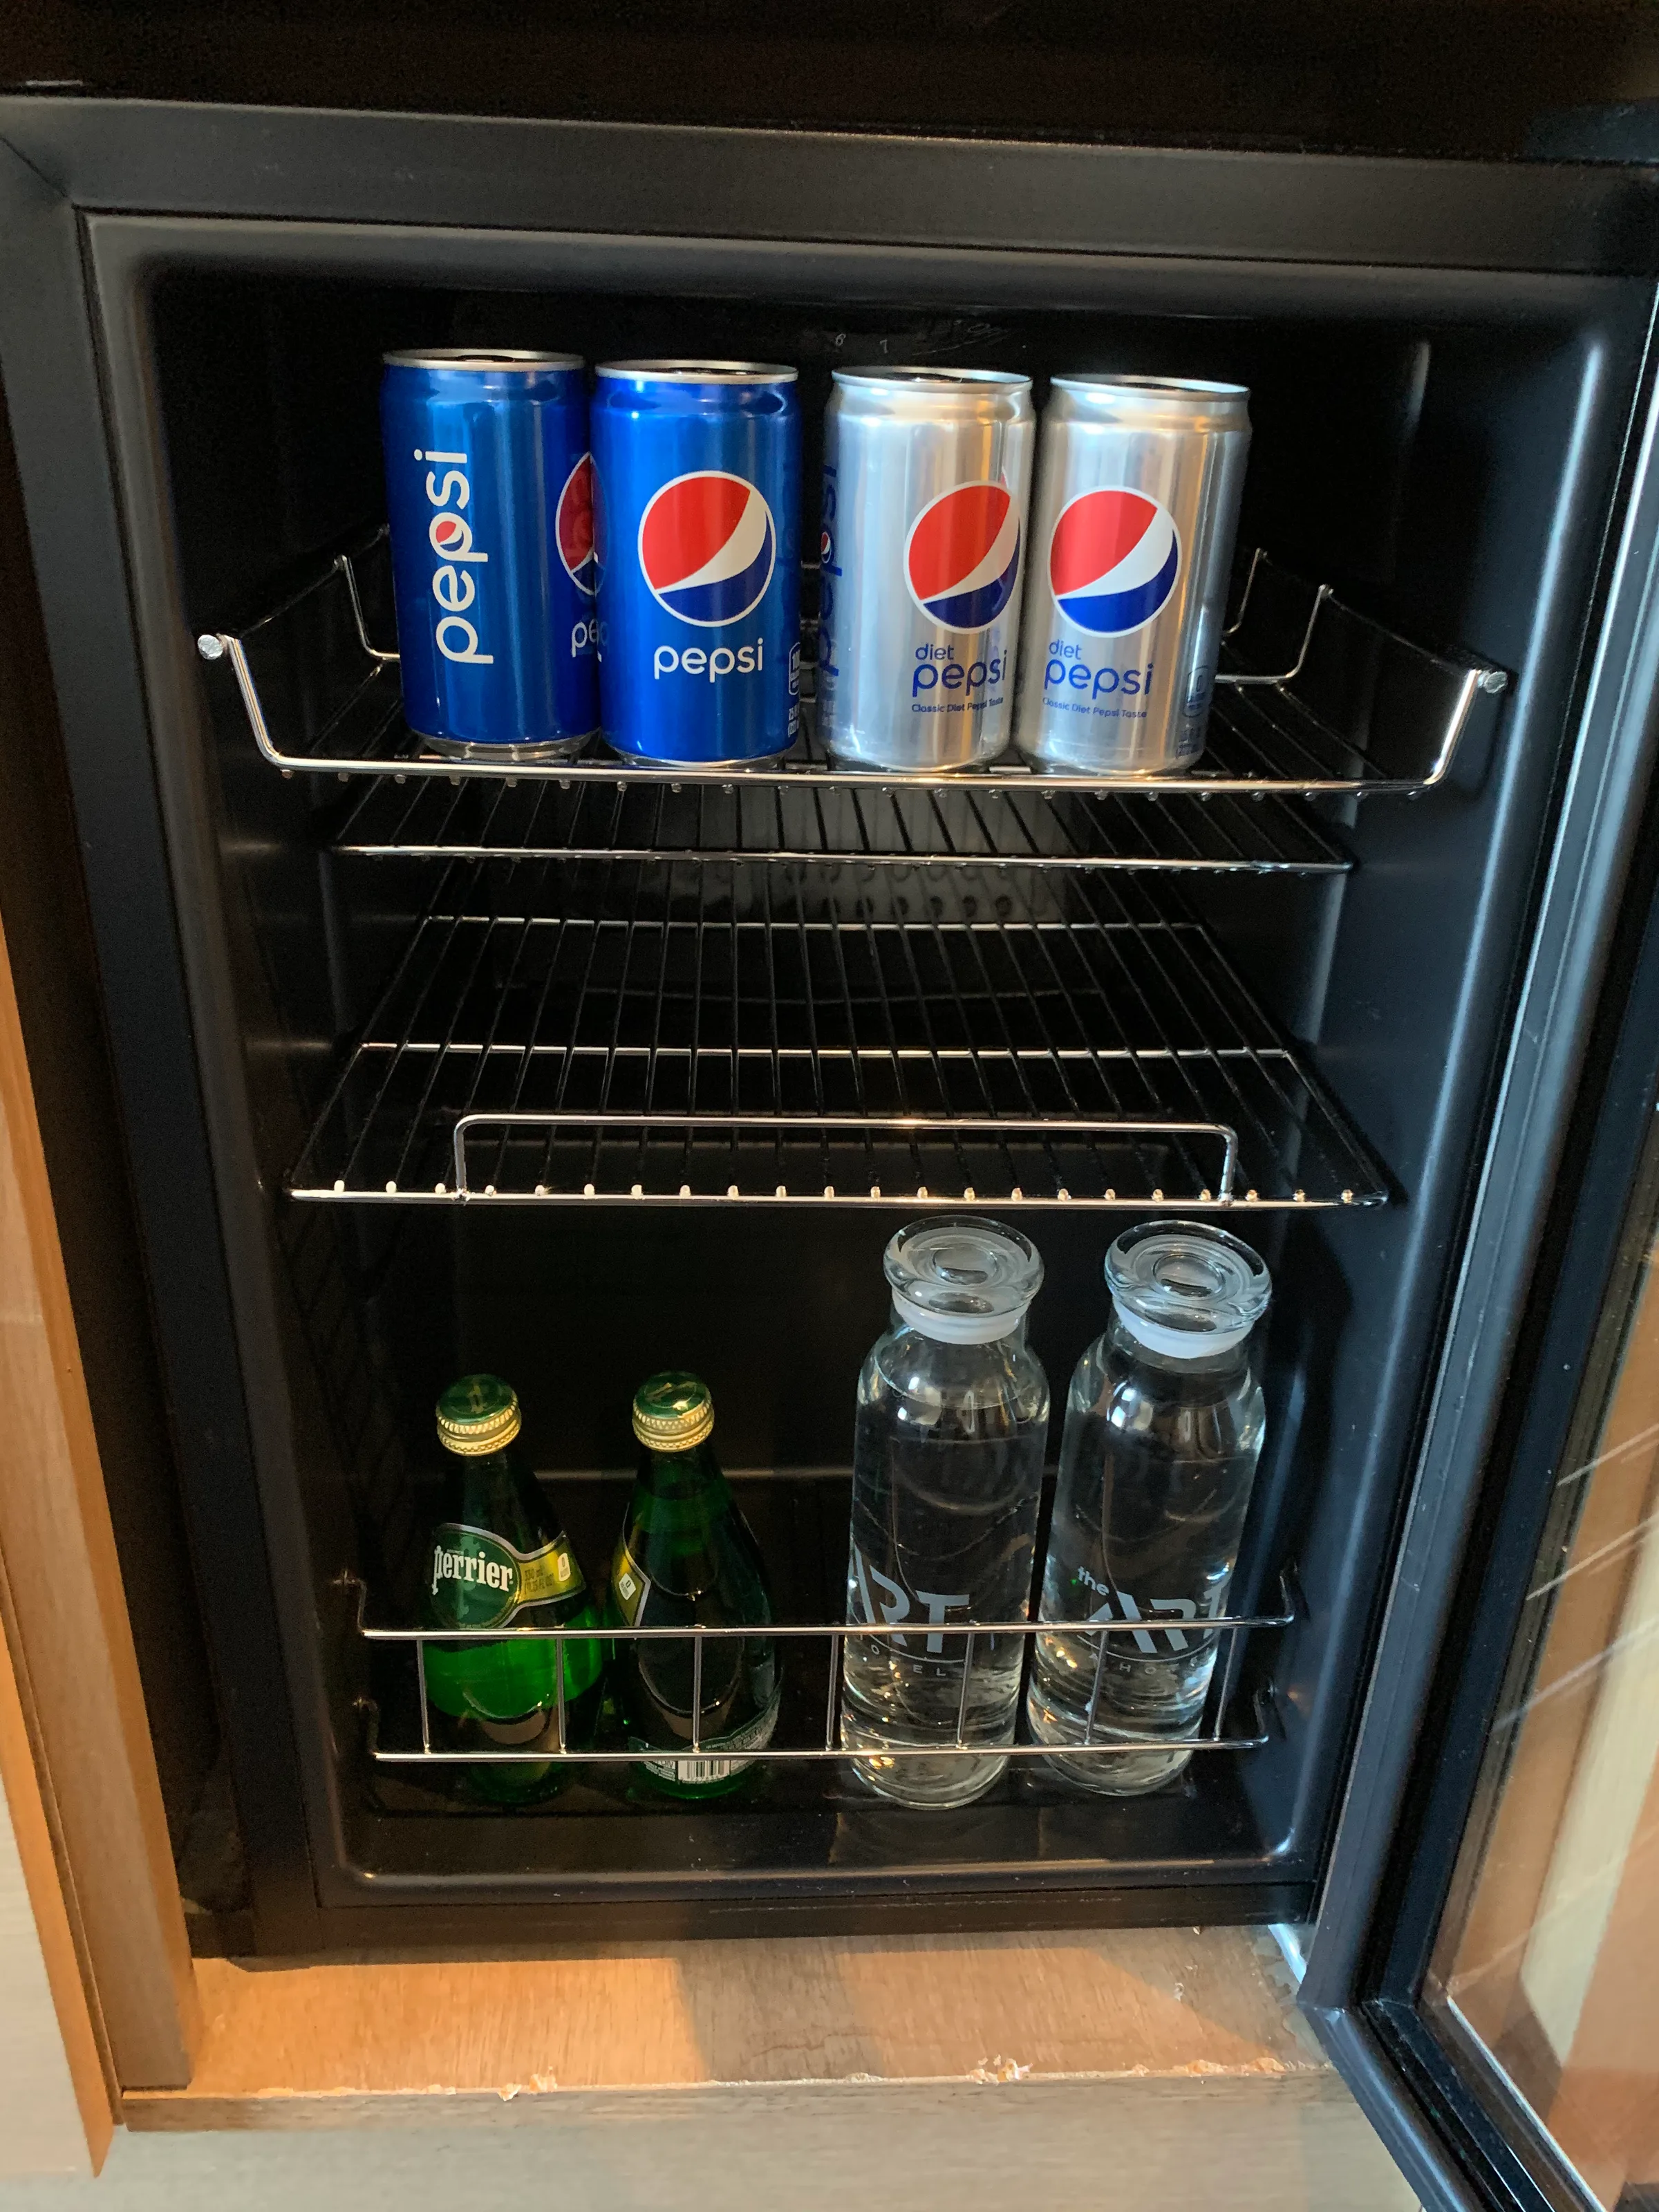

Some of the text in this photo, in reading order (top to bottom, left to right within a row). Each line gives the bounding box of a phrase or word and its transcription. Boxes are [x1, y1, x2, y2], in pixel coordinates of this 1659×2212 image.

[414, 449, 494, 664] pepsi
[654, 638, 763, 684] pepsi
[915, 644, 954, 660] diet
[1049, 639, 1082, 660] diet
[912, 649, 1007, 697] pepsi
[1044, 659, 1154, 700] pepsi
[912, 704, 944, 713] Classic
[946, 703, 965, 713] Diet
[967, 700, 987, 711] Pepsi
[1042, 697, 1147, 718] Classic Diet Pepsi Taste
[1077, 1566, 1109, 1596] the
